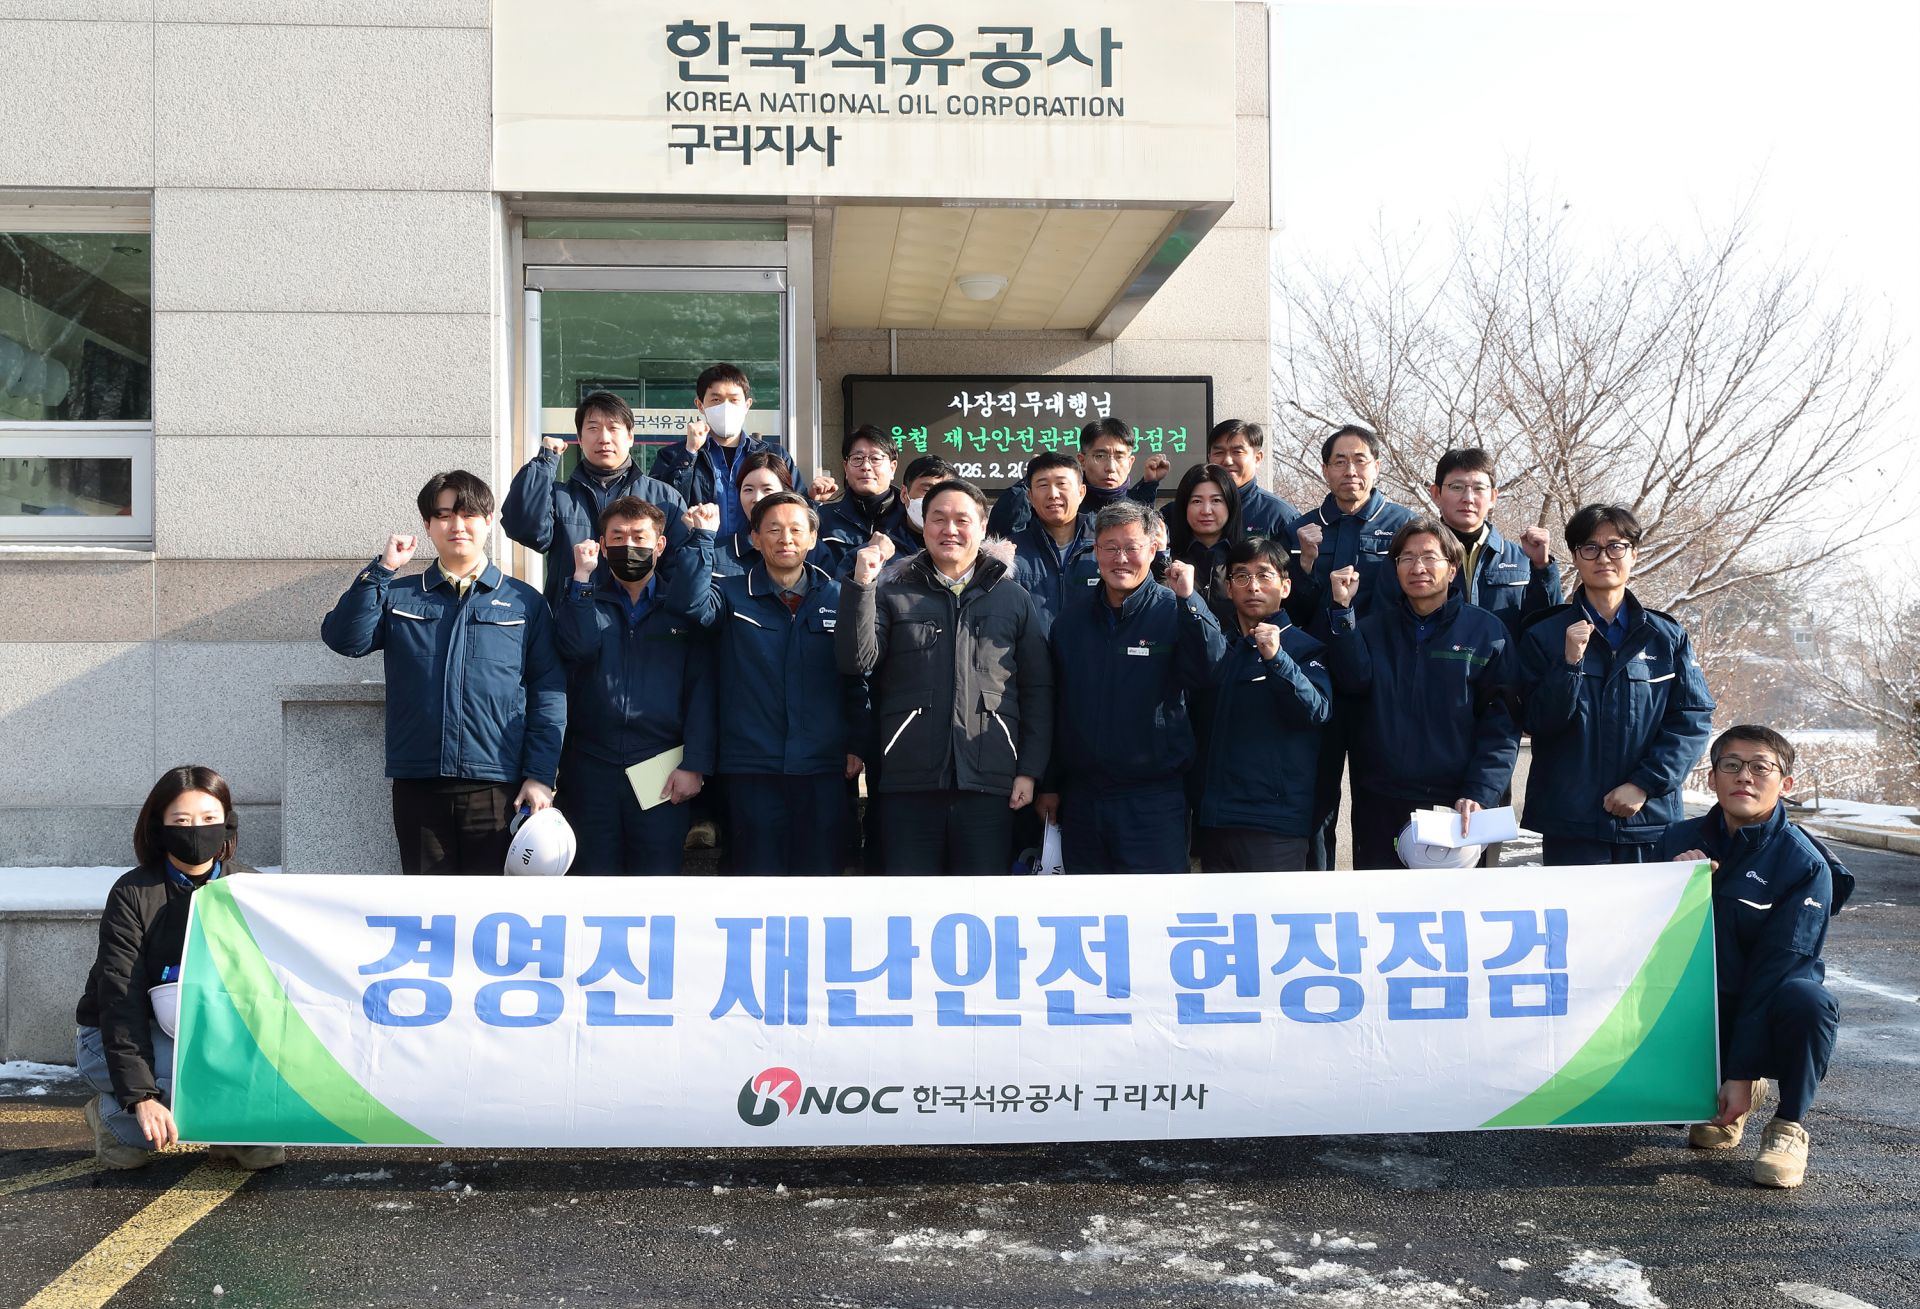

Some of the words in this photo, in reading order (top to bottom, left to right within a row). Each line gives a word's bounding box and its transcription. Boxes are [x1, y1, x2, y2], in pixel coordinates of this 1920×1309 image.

[666, 20, 1123, 89] 한국석유공사
[666, 91, 752, 113] KOREA
[760, 92, 890, 114] NATIONAL
[898, 94, 938, 115] OIL
[946, 96, 1125, 117] CORPORATION
[667, 124, 842, 166] 구리지사
[947, 391, 1111, 418] 사장직무대행님
[634, 415, 701, 430] 국석유공사
[891, 425, 928, 453] 울철
[943, 425, 1083, 453] 재난안전관리
[954, 462, 986, 479] 026.
[522, 848, 534, 865] VIP
[358, 911, 676, 1028] 경영진
[709, 912, 1133, 1028] 재난안전
[1167, 908, 1569, 1024] 현장점검
[737, 1067, 905, 1127] KNOC
[913, 1084, 1084, 1114] 한국석유공사
[1093, 1083, 1209, 1112] 구리지사
